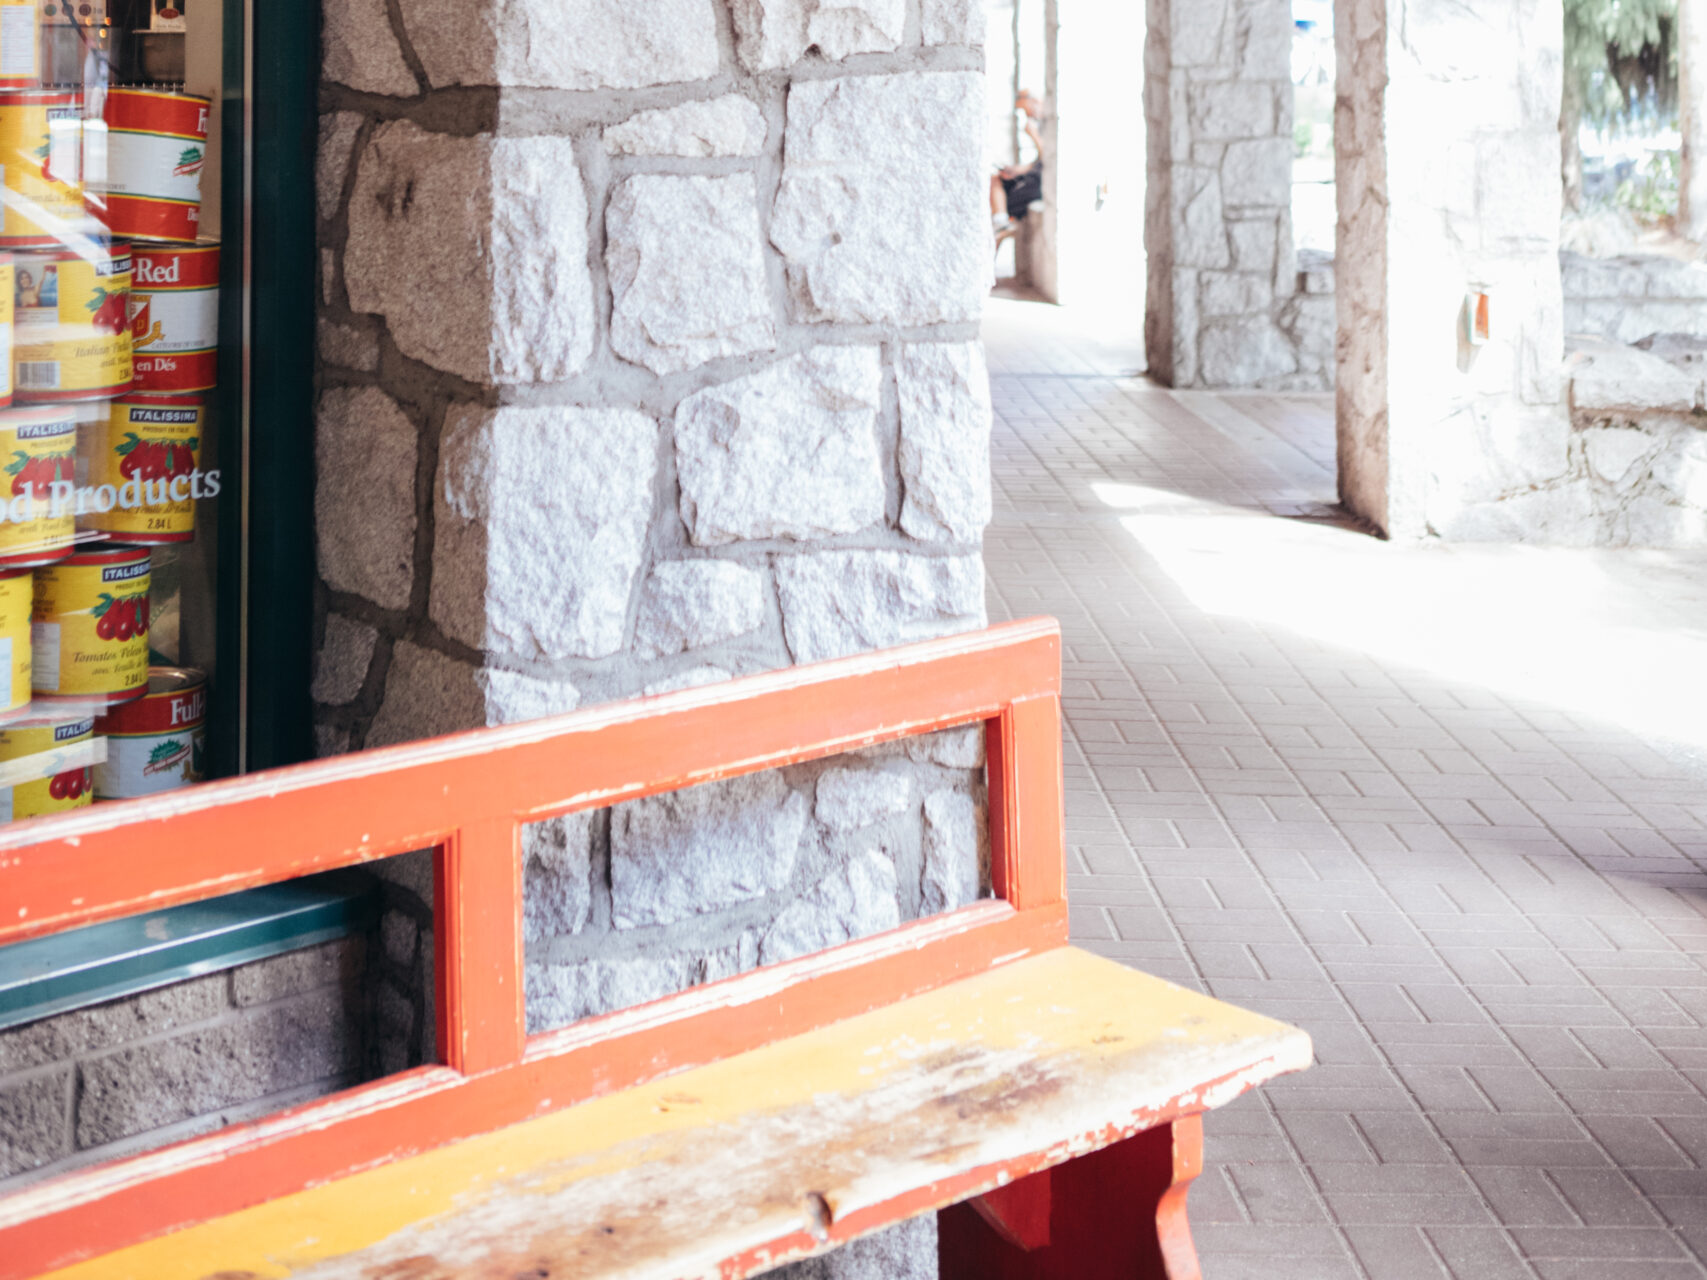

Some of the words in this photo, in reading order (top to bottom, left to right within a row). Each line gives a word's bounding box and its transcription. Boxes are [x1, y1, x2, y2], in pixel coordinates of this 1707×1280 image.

[136, 361, 152, 372] en
[154, 357, 177, 372] Dés
[132, 410, 196, 422] ITALISSIMA
[48, 467, 221, 520] Products
[147, 518, 165, 529] 2.84
[166, 519, 172, 529] L
[73, 650, 117, 663] Tomates
